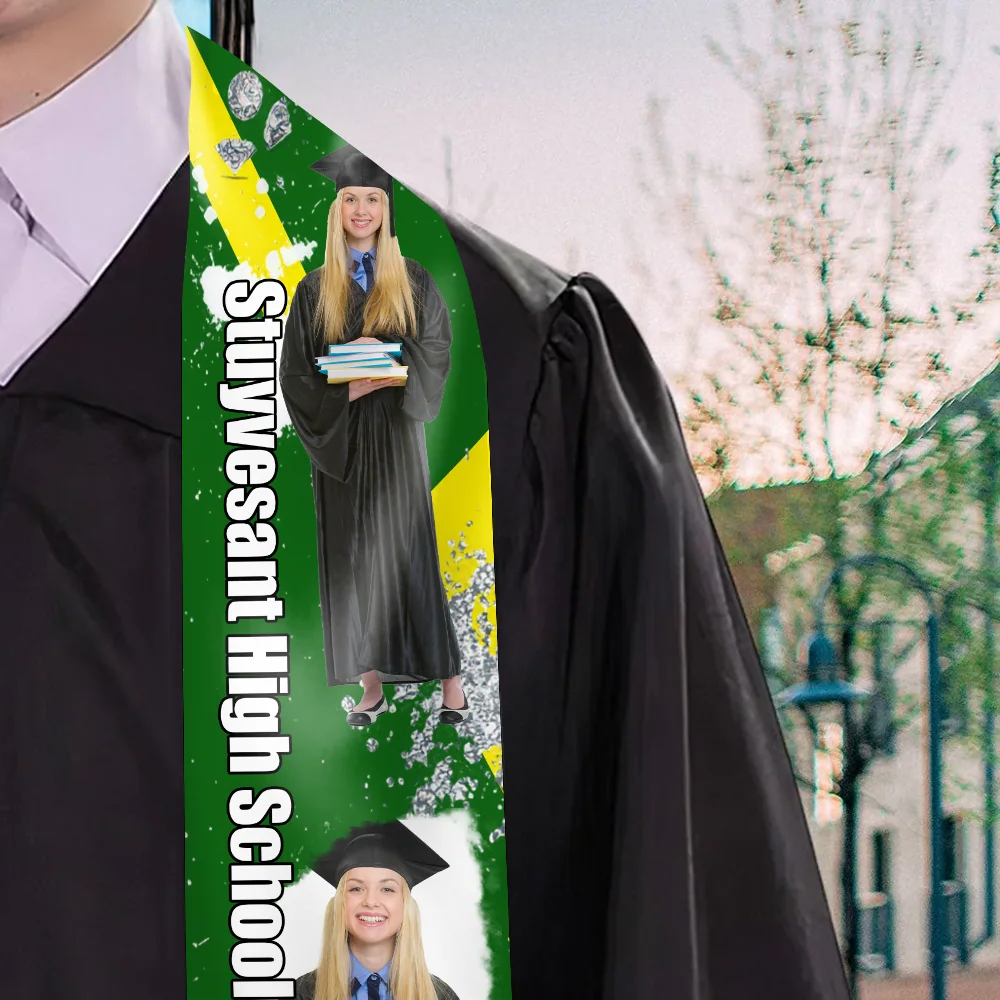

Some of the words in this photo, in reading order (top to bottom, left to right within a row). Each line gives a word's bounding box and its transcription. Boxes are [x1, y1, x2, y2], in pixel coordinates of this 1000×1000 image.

[217, 278, 287, 624] Stuyvesant
[218, 634, 293, 775] High
[227, 786, 297, 1000] School
